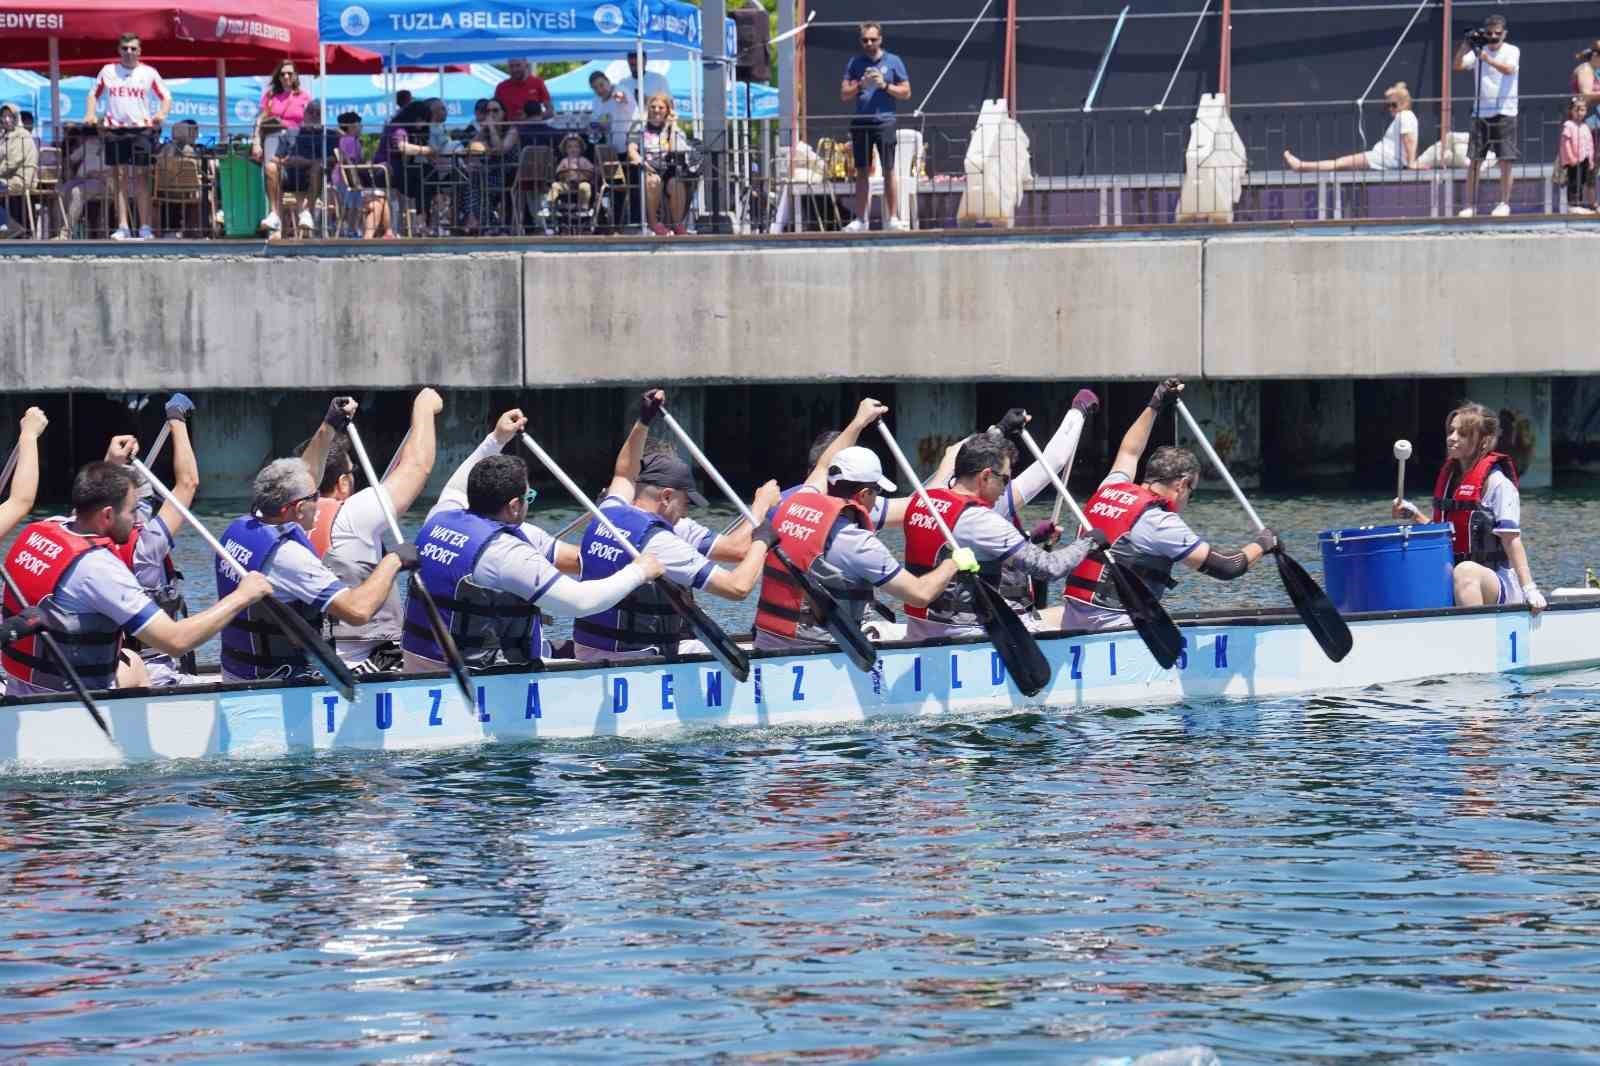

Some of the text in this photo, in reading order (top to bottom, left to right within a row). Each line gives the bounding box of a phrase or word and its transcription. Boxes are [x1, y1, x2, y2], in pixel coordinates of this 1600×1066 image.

[389, 8, 577, 31] TUZLA BELEDİYESİ
[1099, 488, 1139, 506] WATER
[786, 503, 824, 524] WATER
[1089, 502, 1129, 519] SPORT
[430, 525, 470, 548] WATER
[778, 519, 817, 541] SPORT
[25, 531, 64, 560] WATER
[420, 543, 460, 565] SPORT
[587, 541, 624, 562] SPORT
[14, 550, 51, 576] SPORT
[1509, 631, 1517, 663] 1
[322, 681, 542, 733] TUZLA
